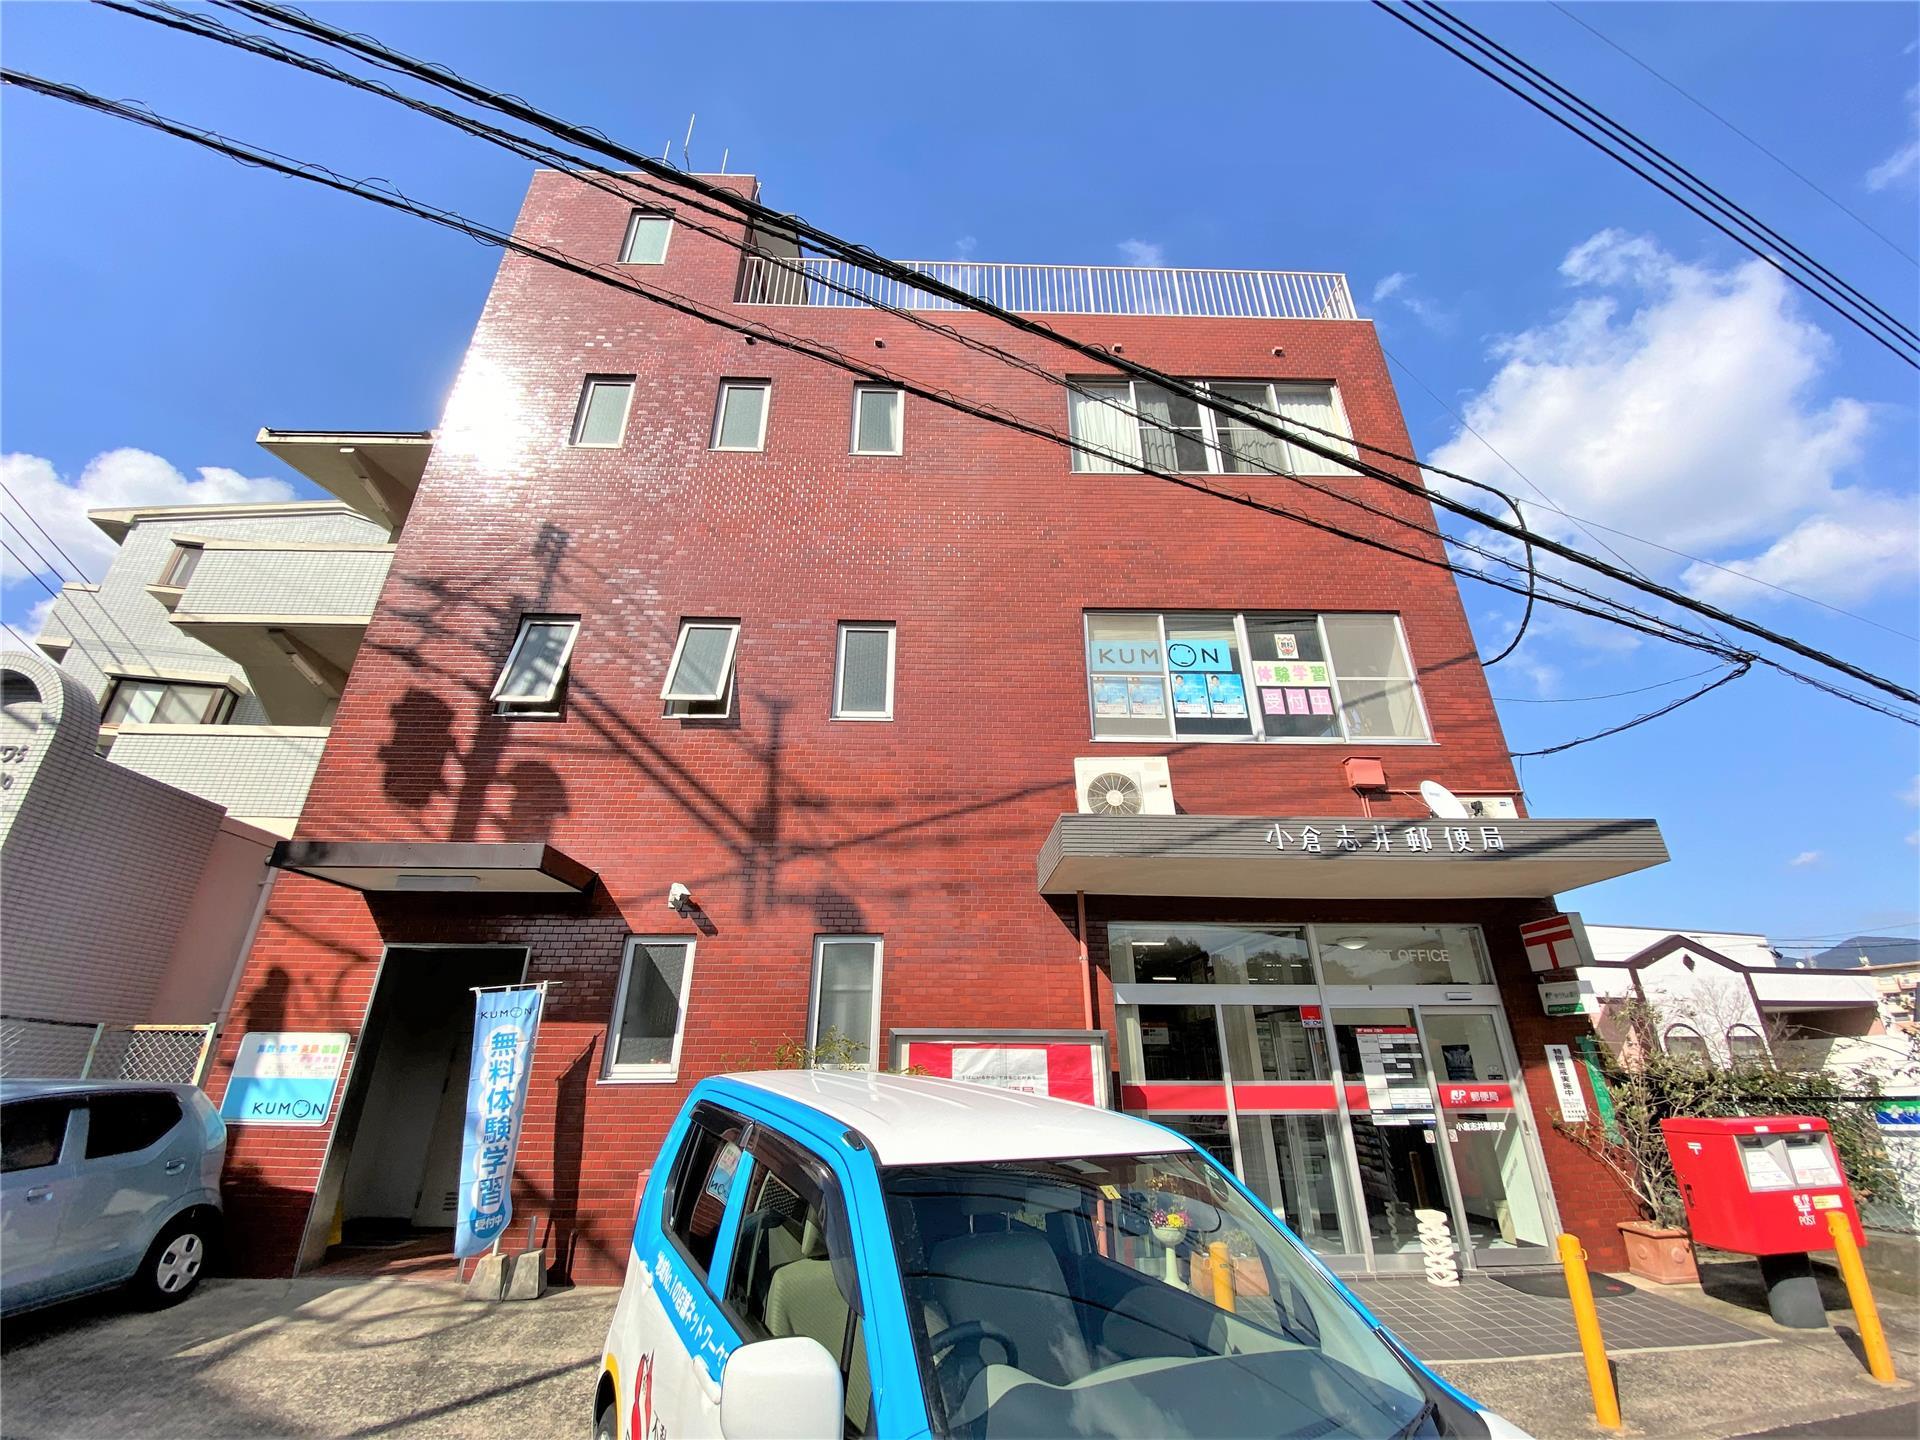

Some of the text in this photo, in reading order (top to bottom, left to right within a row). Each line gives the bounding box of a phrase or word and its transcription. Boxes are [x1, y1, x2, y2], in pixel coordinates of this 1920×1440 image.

[1099, 643, 1219, 668] KUMON
[1257, 665, 1328, 682] 体験学習
[1265, 692, 1330, 710] 受付中
[1266, 823, 1505, 853] 小倉志井郵便局
[1398, 949, 1451, 962] OFFICE
[480, 1005, 533, 1020] KUMON
[252, 1099, 325, 1119] KUMON
[480, 1031, 519, 1207] 無料体験学習
[1799, 1215, 1816, 1226] POST
